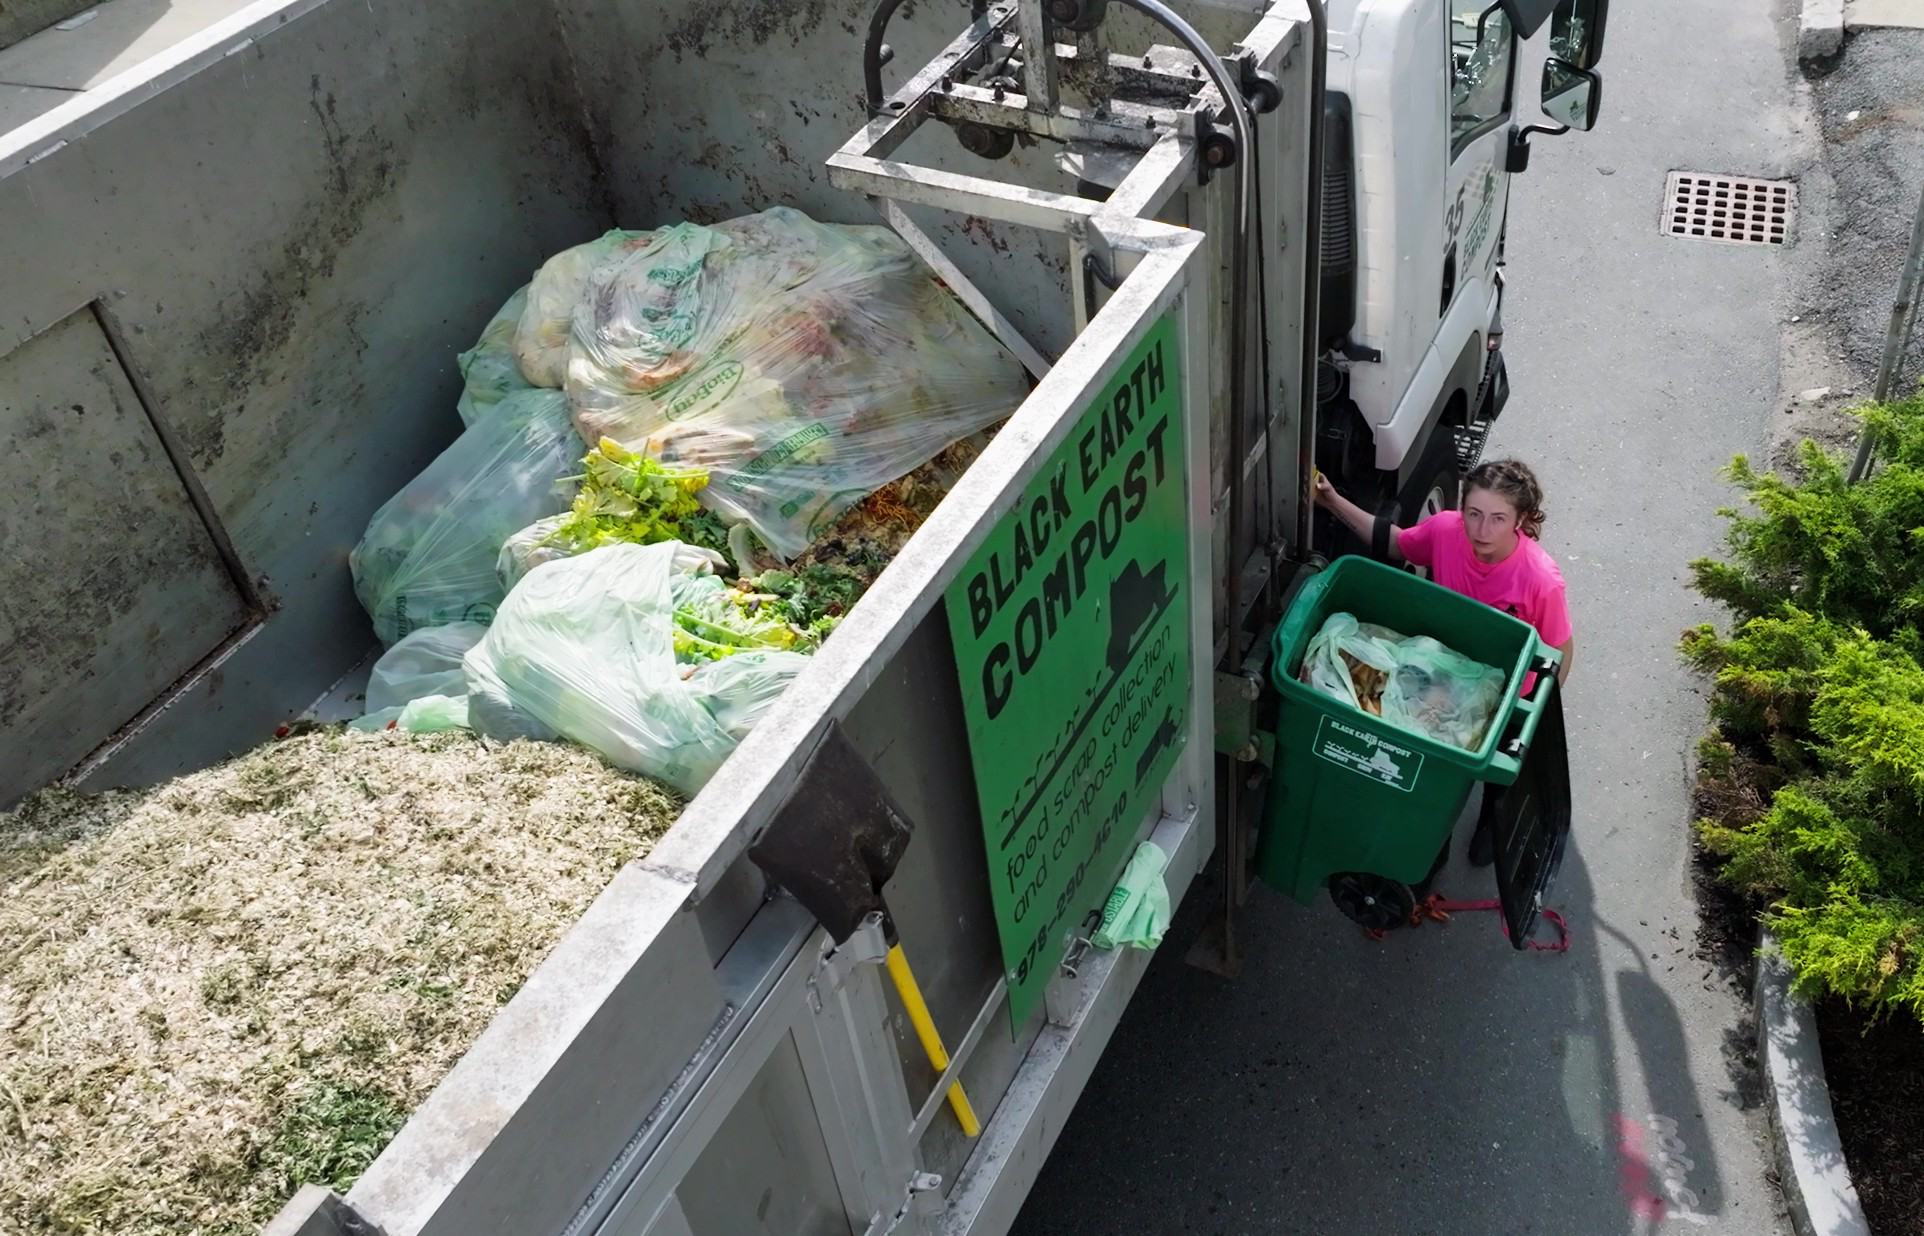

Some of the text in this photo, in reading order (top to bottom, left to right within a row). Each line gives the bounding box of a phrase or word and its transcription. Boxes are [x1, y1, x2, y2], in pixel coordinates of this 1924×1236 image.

[967, 338, 1166, 641] BLACK EARTH
[982, 413, 1168, 721] COMPOST
[1005, 800, 1049, 894] food
[1054, 735, 1097, 815] scrap
[1102, 624, 1170, 738] collection
[1013, 856, 1048, 924] and
[1052, 741, 1119, 861] compost
[1122, 653, 1177, 748] delivery
[1331, 721, 1355, 736] BLACK
[1378, 740, 1412, 758] COMPOST
[1015, 788, 1128, 988] 978-290-4610
